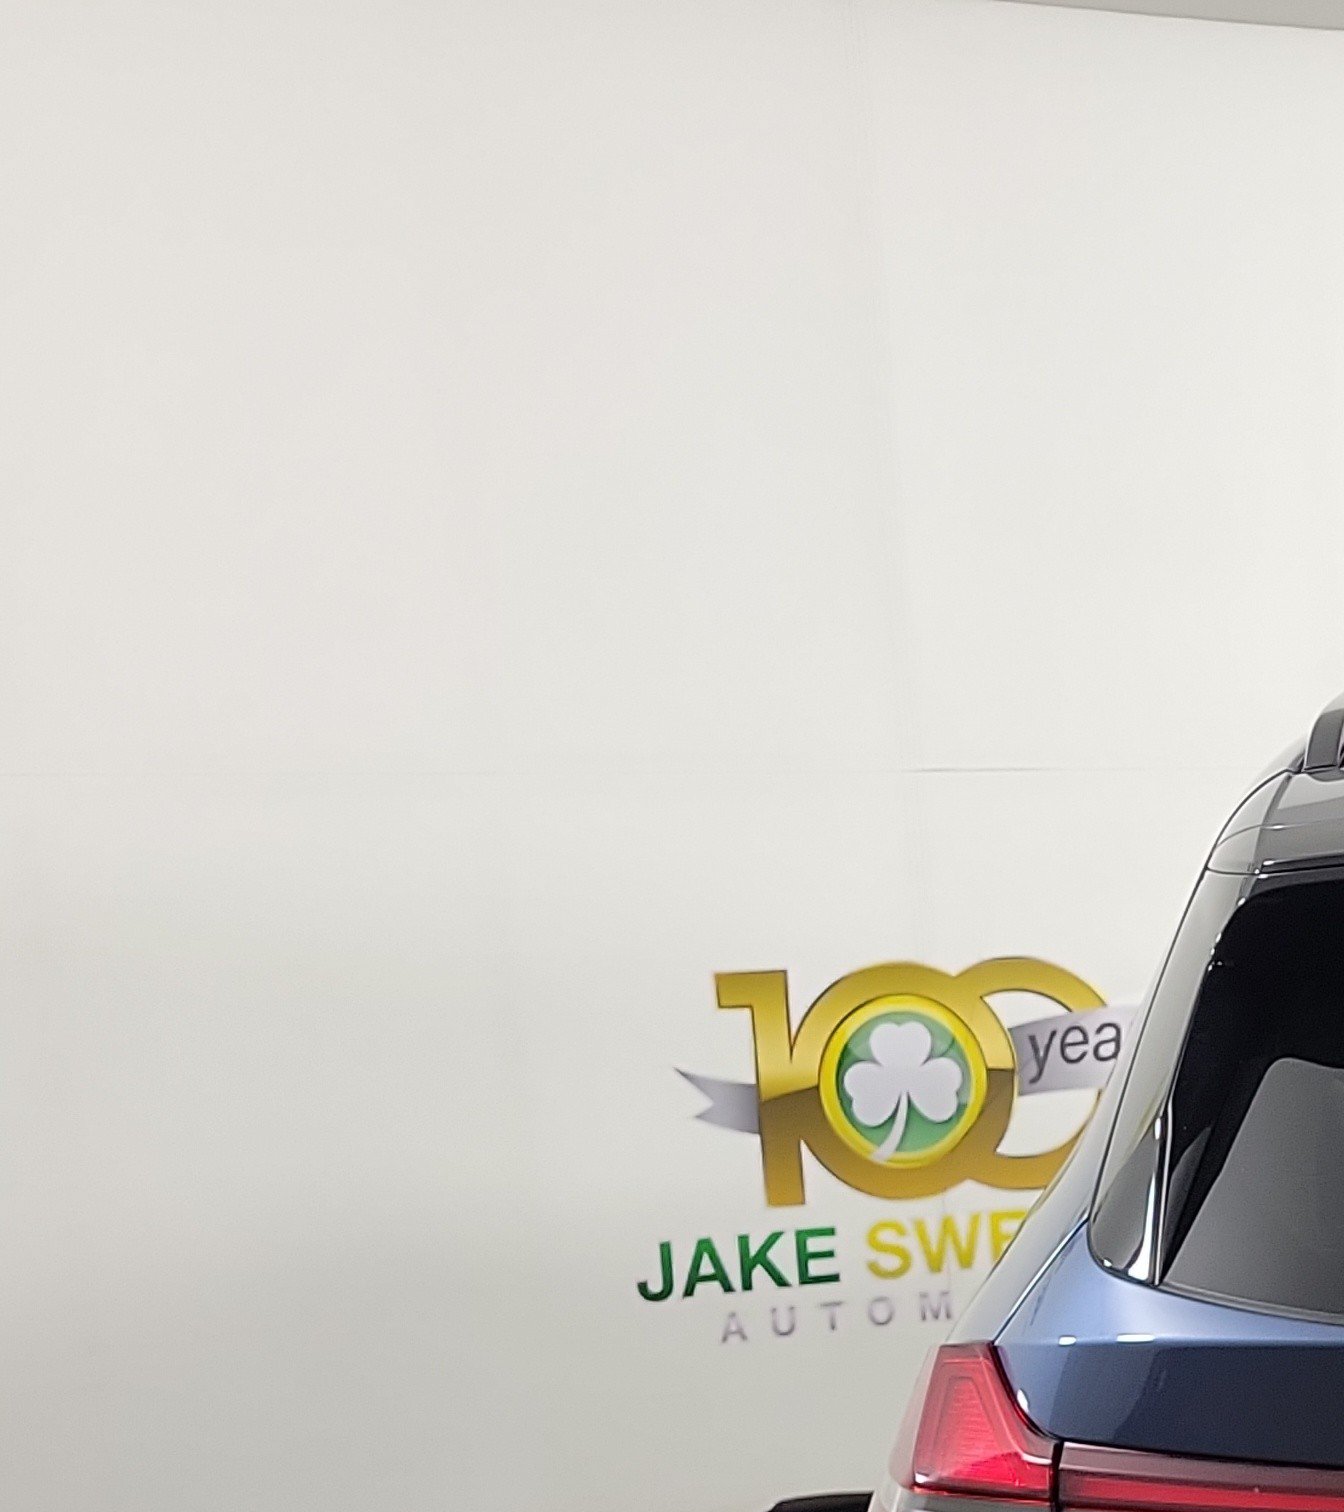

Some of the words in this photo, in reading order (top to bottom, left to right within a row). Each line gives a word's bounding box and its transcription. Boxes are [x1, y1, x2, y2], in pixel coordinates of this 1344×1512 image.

[714, 957, 1108, 1208] 100
[1028, 1022, 1121, 1085] yea
[636, 1226, 841, 1302] JAKE
[720, 1291, 953, 1344] AUTOM
